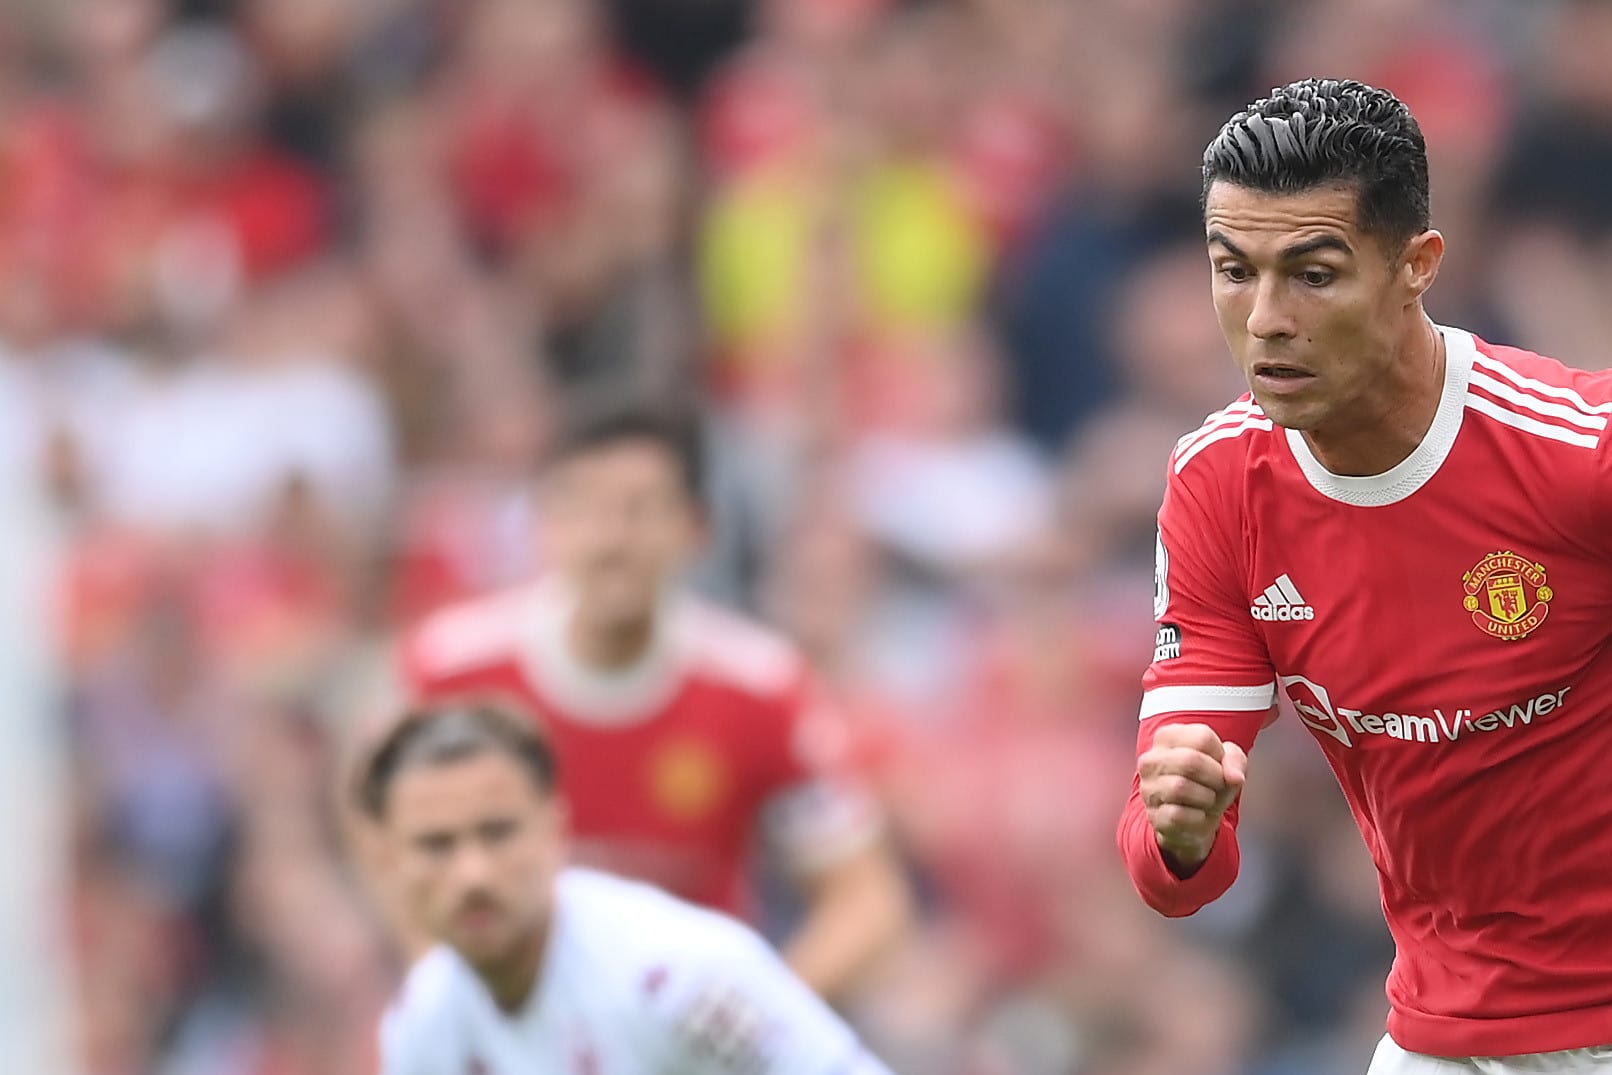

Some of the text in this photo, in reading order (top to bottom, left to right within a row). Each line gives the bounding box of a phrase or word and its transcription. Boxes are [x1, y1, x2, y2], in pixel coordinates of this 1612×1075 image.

[1469, 557, 1540, 589] MANCHESTER
[1250, 603, 1315, 622] adidas
[1487, 616, 1538, 635] UNITED
[1337, 686, 1571, 743] TeamViewer
